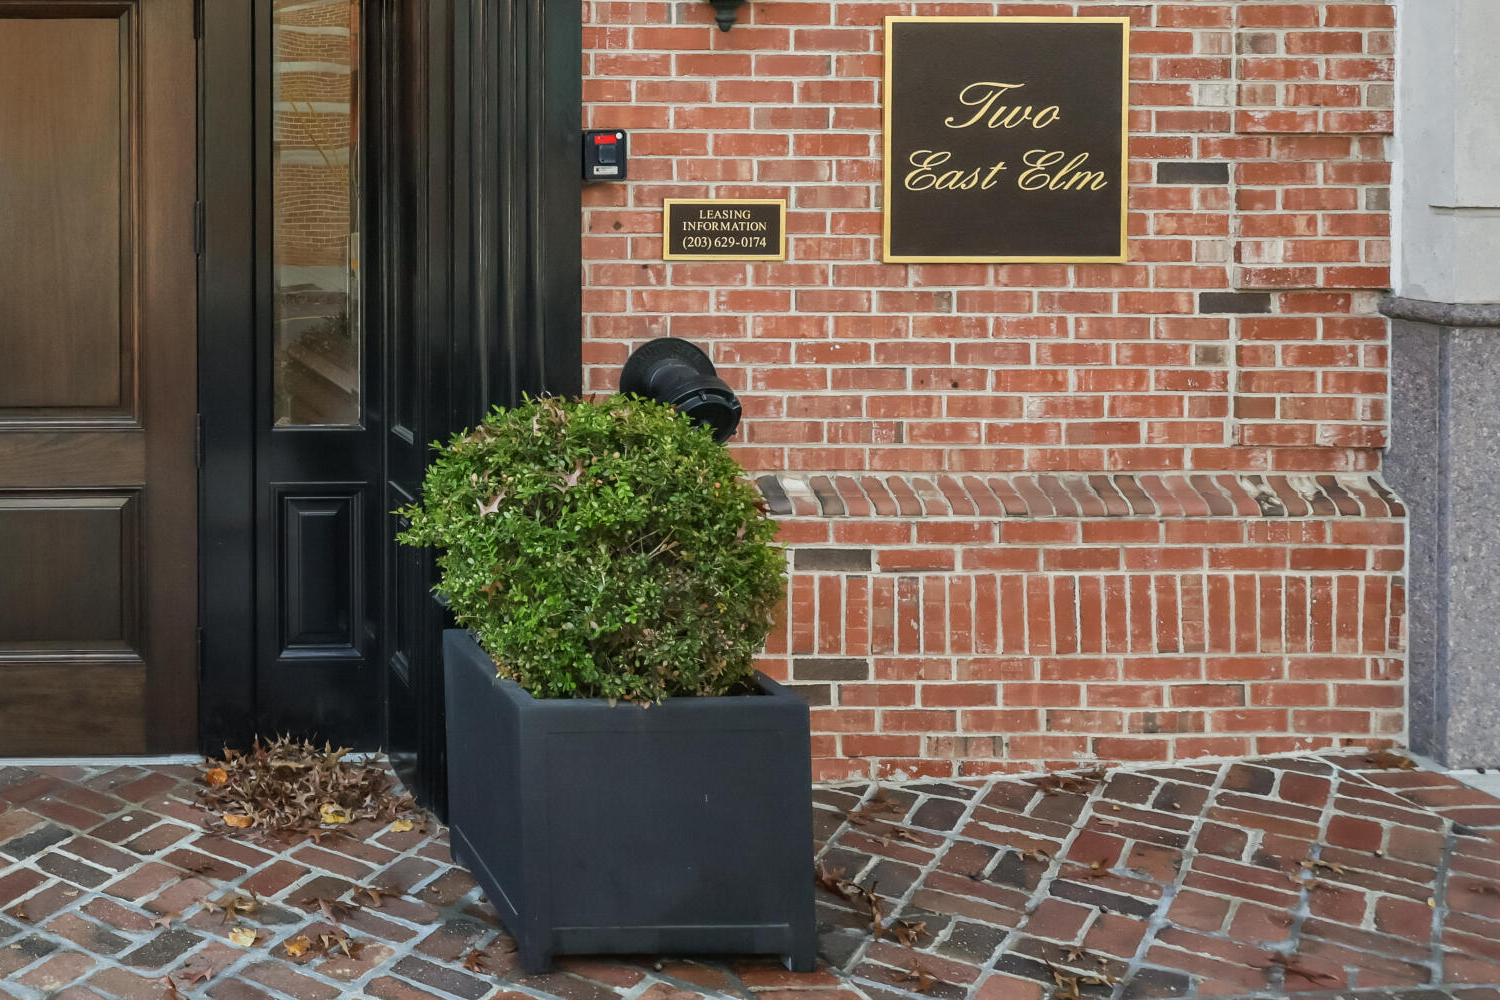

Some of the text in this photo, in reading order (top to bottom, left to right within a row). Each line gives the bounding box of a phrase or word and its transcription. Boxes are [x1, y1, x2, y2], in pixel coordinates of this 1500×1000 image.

[944, 81, 1061, 129] Two
[904, 149, 1108, 191] East Elm
[699, 209, 751, 220] LEASING
[682, 221, 767, 231] INFORMATION
[682, 236, 767, 250] (203) 629-0174
